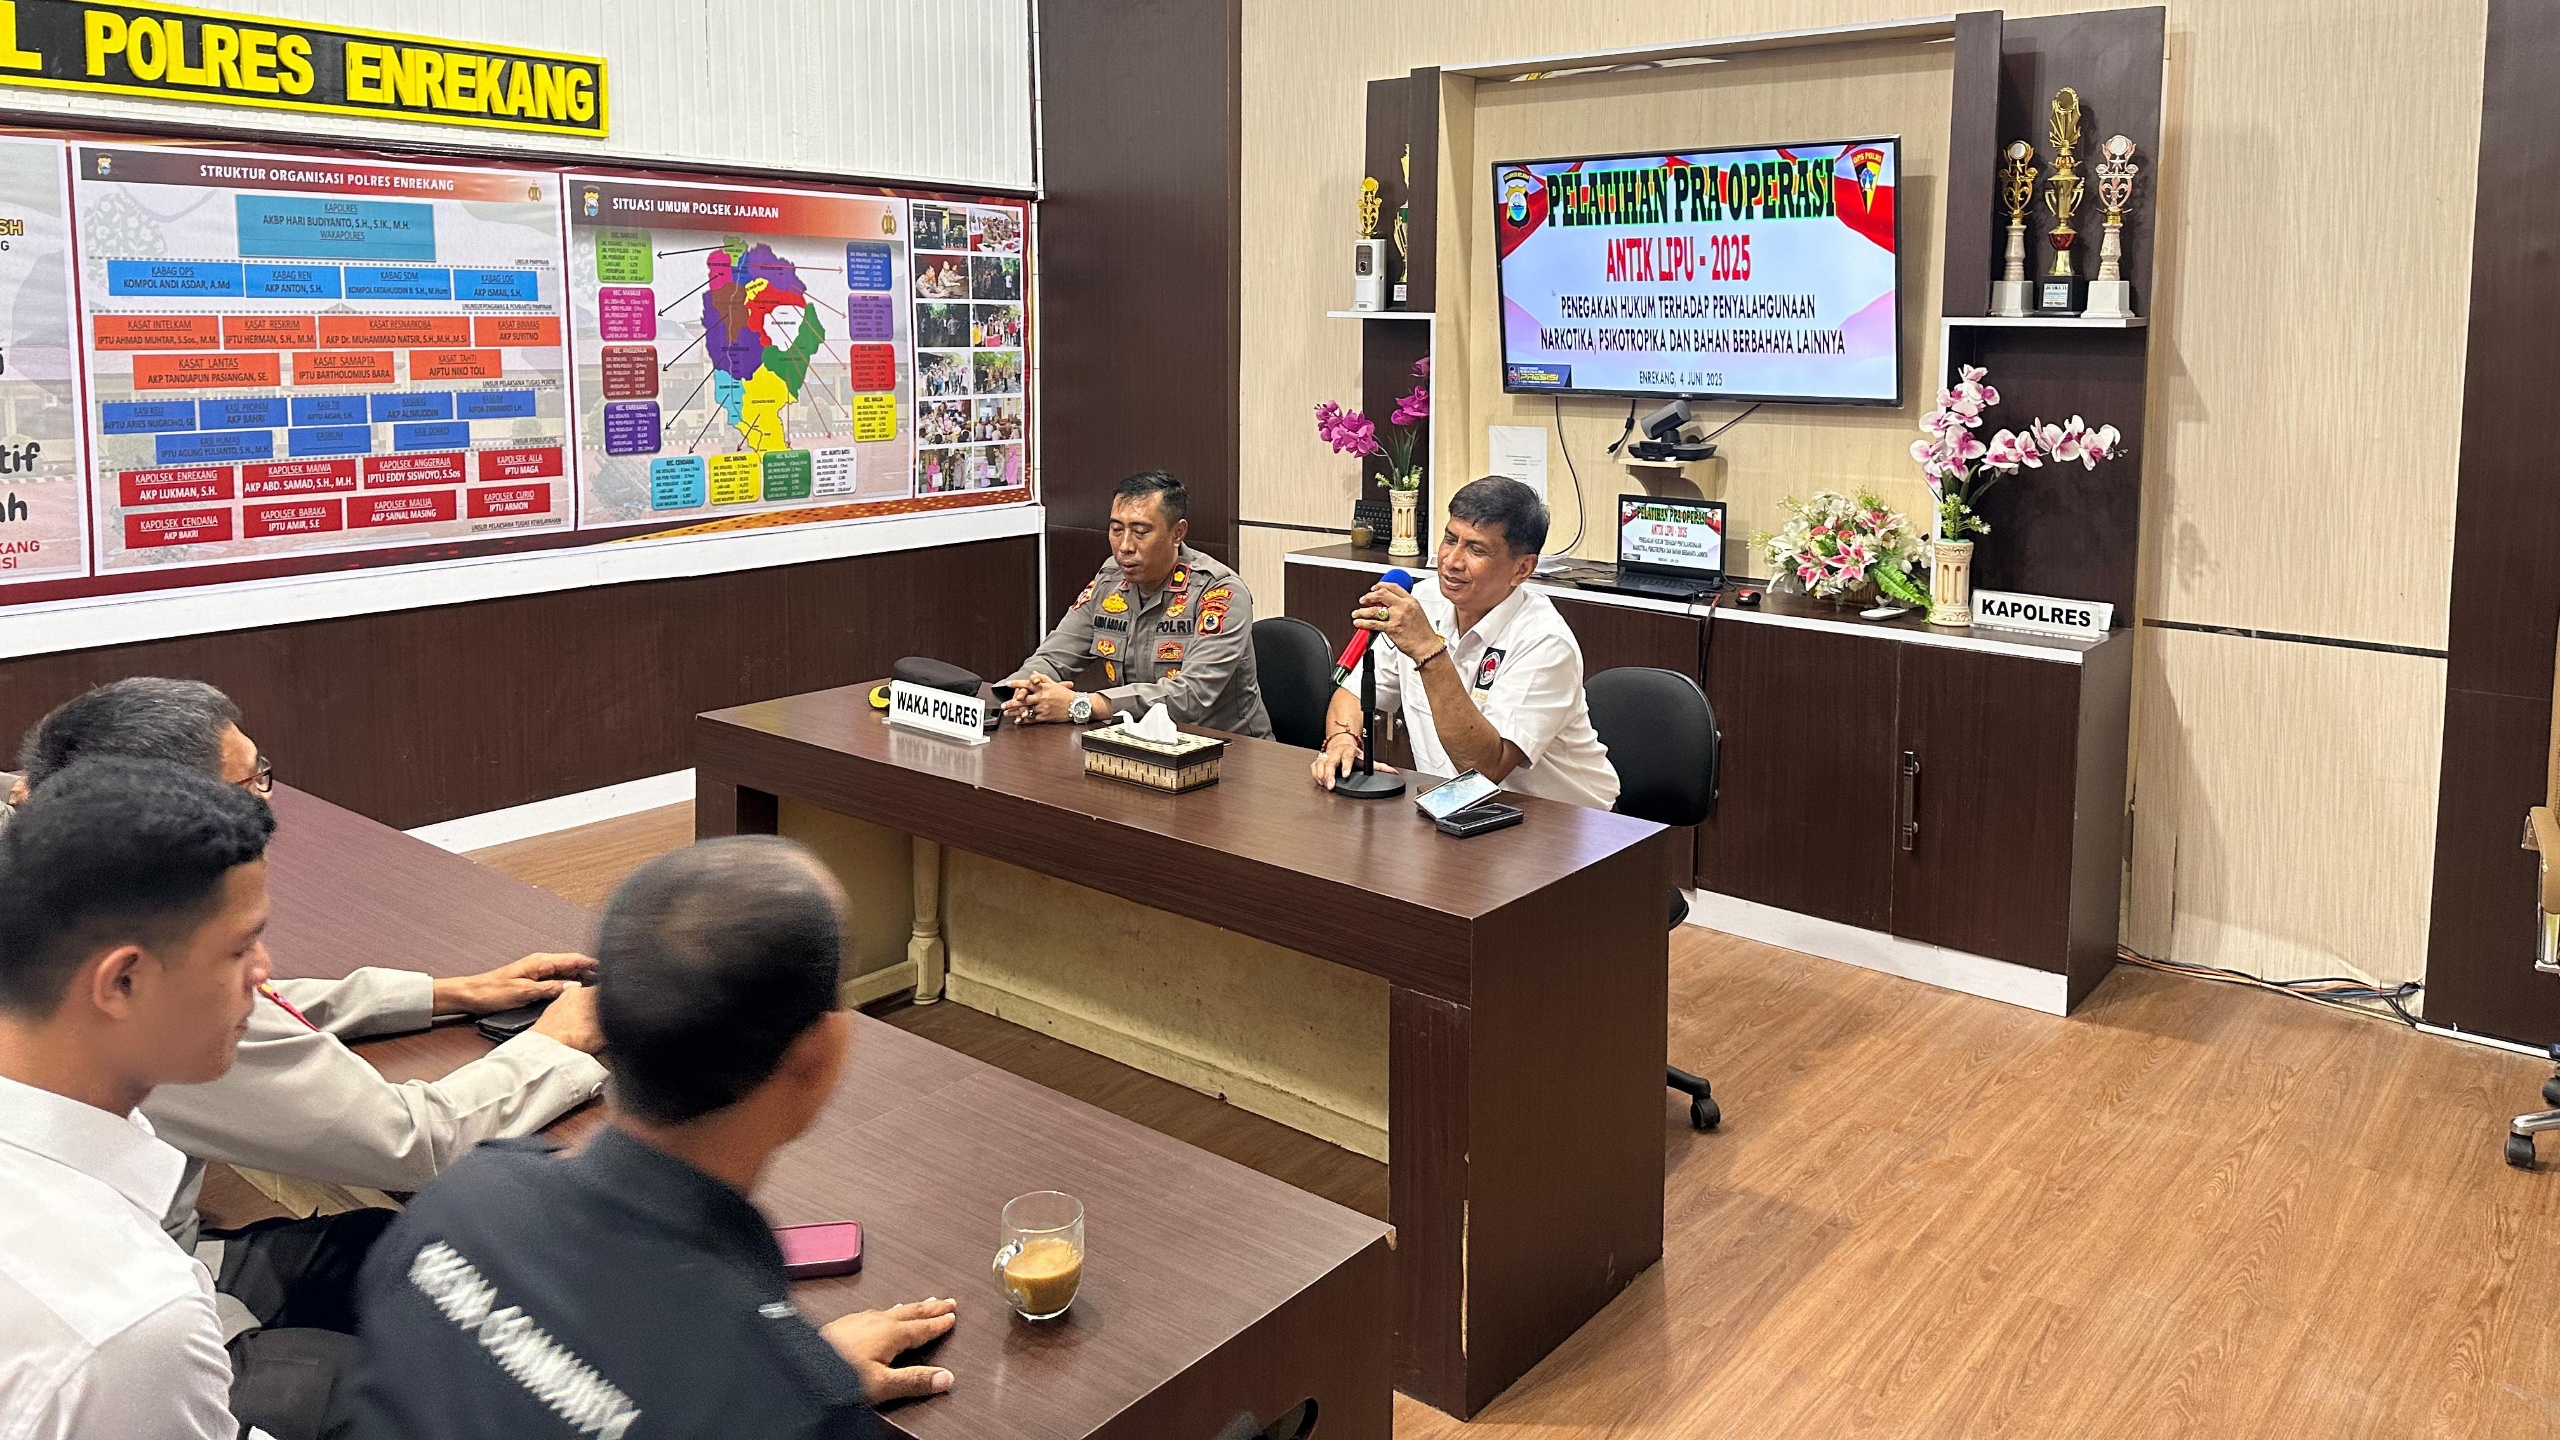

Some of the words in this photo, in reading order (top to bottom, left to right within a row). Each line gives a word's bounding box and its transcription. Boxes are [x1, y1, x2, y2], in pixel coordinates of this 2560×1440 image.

[86, 9, 316, 95] POLRES
[345, 41, 595, 122] ENREKANG
[200, 165, 266, 180] STRUKTUR
[270, 168, 344, 185] ORGANISASI
[347, 175, 390, 187] POLRES
[394, 177, 454, 191] ENREKANG
[1546, 167, 1669, 228] PELATIHAN
[1674, 163, 1722, 224] PRA
[1728, 157, 1837, 221] OPERASI
[324, 204, 357, 213] KAPOLRES
[613, 197, 655, 211] SITUASI
[657, 200, 690, 212] UMUM
[692, 202, 732, 215] POLSEK
[734, 204, 779, 218] JAJARAN
[263, 215, 284, 224] AKBP
[286, 216, 305, 225] HARI
[307, 217, 354, 228] BUDIYANTO,
[321, 231, 364, 240] WAKAPOLRES
[1606, 238, 1653, 282] ANTIK
[1659, 236, 1695, 281] LIPU
[1700, 256, 1706, 266] -
[1712, 234, 1751, 281] 2025
[152, 266, 177, 275] KABAG
[179, 267, 194, 276] OPS
[272, 271, 296, 279] KABAG
[297, 272, 312, 280] REN
[381, 272, 403, 280] KABAG
[405, 272, 418, 280] SDM
[482, 275, 503, 283] KABAG
[124, 279, 158, 289] KOMPOL
[160, 280, 179, 289] ANDI
[181, 279, 208, 290] ASDAR,
[210, 280, 230, 289] A.Md
[265, 284, 279, 292] AKP
[281, 284, 308, 294] ANTON,
[474, 288, 486, 296] AKP
[1561, 297, 1618, 319] PENEGAKAN
[1620, 296, 1655, 319] HUKUM
[1659, 296, 1709, 319] TERHADAP
[1713, 295, 1815, 319] PENYALAHGUNAAN
[128, 320, 150, 329] KASAT
[153, 320, 191, 329] INTELKAM
[245, 320, 266, 329] KASAT
[270, 320, 300, 329] RESKRIM
[370, 320, 390, 329] KASAT
[391, 320, 431, 329] RESNARKOBA
[498, 321, 515, 329] KASAT
[517, 321, 539, 329] BINMAS
[98, 336, 114, 344] IPTU
[116, 336, 142, 344] AHMAD
[144, 336, 176, 345] MUHTAR,
[226, 336, 242, 344] IPTU
[244, 336, 278, 344] HERMAN,
[326, 336, 339, 344] AKP
[352, 335, 395, 344] MUHAMMAD
[1541, 328, 1596, 354] NARKOTIKA,
[1599, 328, 1666, 352] PSIKOTROPIKA
[1669, 328, 1690, 352] DAN
[1694, 329, 1730, 352] BAHAN
[1733, 329, 1794, 354] BERBAHAYA
[1797, 330, 1845, 354] LAINNYA
[179, 359, 203, 369] KASAT
[208, 359, 238, 368] LANTAS
[314, 357, 337, 366] KASAT
[340, 356, 374, 366] SAMAPTA
[438, 355, 457, 363] KASAT
[460, 355, 477, 363] TAHTI
[299, 371, 315, 379] IPTU
[317, 370, 370, 379] BARTHOLOMIUS
[372, 370, 390, 378] BARA
[430, 367, 450, 376] AIPTU
[452, 367, 467, 376] NIKO
[148, 375, 164, 383] AKP
[1640, 371, 1677, 386] ENREKANG,
[1680, 372, 1684, 385] 4
[1688, 372, 1704, 386] JUNI
[1707, 372, 1722, 386] 2025
[380, 460, 412, 469] KAPOLSEK
[415, 458, 451, 467] ANGGERAJA
[497, 455, 526, 464] KAPOLSEK
[529, 454, 542, 462] ALLA
[268, 466, 303, 474] KAPOLSEK
[306, 464, 331, 473] MAIWA
[505, 466, 519, 474] IPTU
[520, 466, 539, 474] MAGA
[135, 473, 174, 483] KAPOLSEK
[177, 471, 217, 481] ENREKANG
[367, 474, 384, 483] IPTU
[387, 473, 405, 481] EDDY
[407, 471, 441, 480] SISWOYO,
[245, 483, 261, 492] AKP
[263, 481, 281, 490] ABD.
[283, 480, 315, 489] SAMAD,
[139, 490, 157, 500] AKP
[159, 488, 199, 499] LUKMAN,
[201, 486, 217, 496] S.H.
[484, 493, 513, 501] KAPOLSEK
[516, 491, 535, 499] CURIO
[374, 501, 406, 510] KAPOLSEK
[410, 498, 432, 507] MALUA
[490, 504, 503, 512] IPTU
[505, 503, 528, 511] ARMON
[261, 510, 295, 520] KAPOLSEK
[299, 507, 326, 516] BARAKA
[371, 513, 384, 521] AKP
[386, 511, 409, 521] SAINAL
[410, 509, 436, 519] MASING
[140, 520, 178, 530] KAPOLSEK
[182, 516, 218, 526] CENDANA
[269, 522, 285, 531] IPTU
[1982, 599, 2091, 627] KAPOLRES
[1156, 620, 1192, 633] POLRI
[897, 691, 929, 716] WAKA
[933, 698, 978, 728] POLRES
